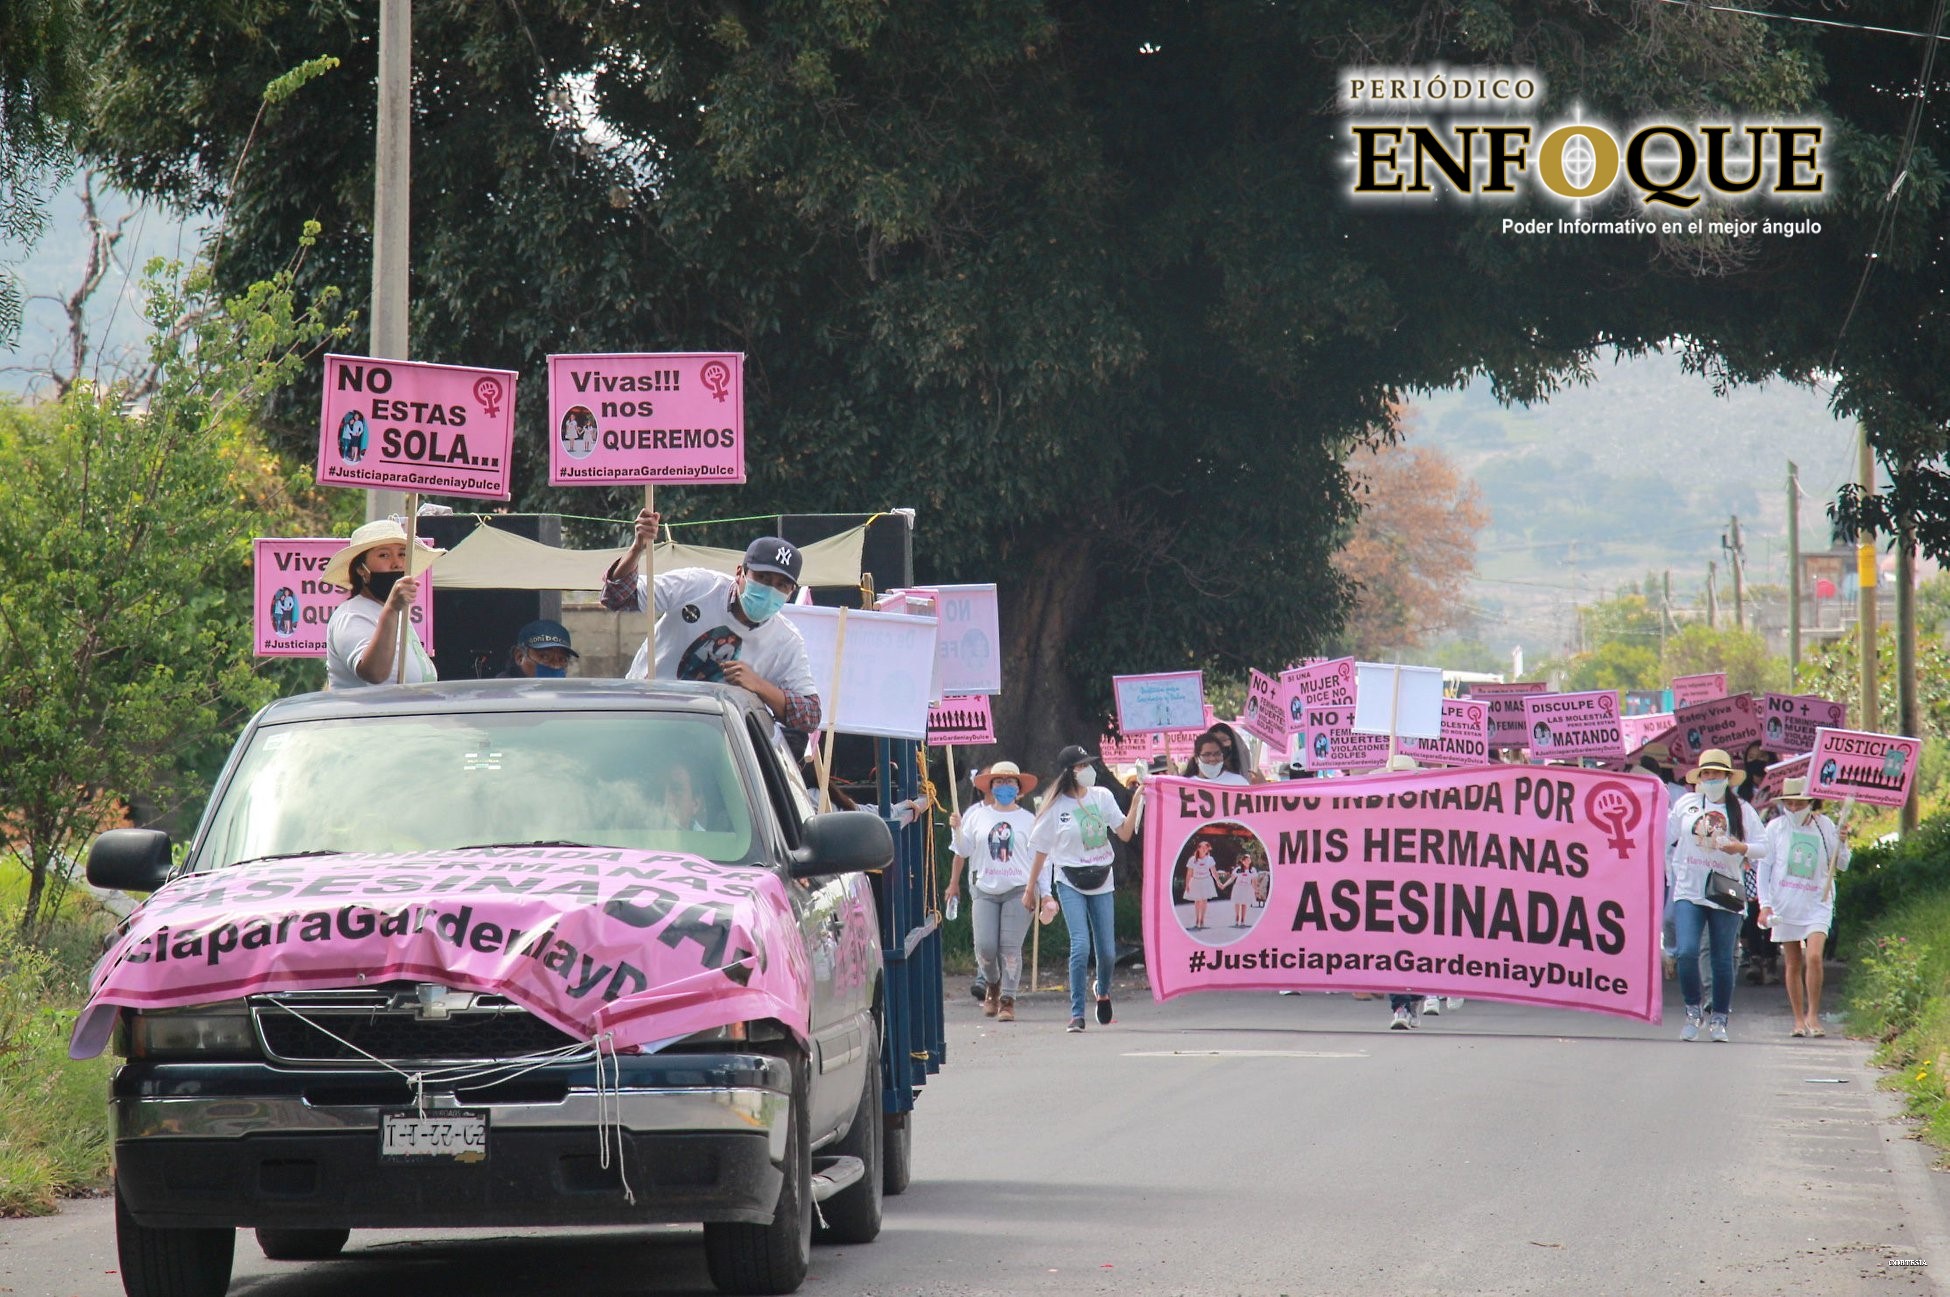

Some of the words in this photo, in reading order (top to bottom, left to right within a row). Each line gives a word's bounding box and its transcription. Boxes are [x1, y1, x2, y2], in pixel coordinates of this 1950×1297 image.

[338, 364, 392, 394] NO
[570, 370, 680, 392] Vivas!!!
[371, 399, 467, 427] ESTAS
[601, 401, 653, 417] nos
[381, 428, 499, 467] SOLA...
[603, 428, 735, 451] QUEREMOS
[329, 466, 500, 491] #JusticiaparaGardeniayDulce
[560, 465, 734, 478] #JusticiaparaGardeniayDulce
[274, 552, 330, 571] Viva
[1253, 676, 1268, 694] NO
[1300, 675, 1340, 694] MUJER
[1307, 691, 1329, 704] DICE
[1332, 687, 1347, 698] NO
[1532, 700, 1594, 713] DISCULPE
[1680, 710, 1706, 723] Estoy
[1708, 705, 1732, 717] Viva
[1769, 698, 1794, 713] NO
[1310, 712, 1338, 726] NO
[1547, 716, 1564, 724] LAS
[1566, 713, 1613, 722] MOLESTIAS
[1699, 719, 1736, 735] Puedo
[1330, 735, 1390, 744] MUERTES
[1553, 728, 1619, 747] MATANDO
[1711, 728, 1757, 745] Contarlo
[1419, 737, 1484, 756] MATANDO
[1515, 776, 1575, 824] POR
[1278, 828, 1348, 867] MIS
[1364, 828, 1589, 878] HERMANAS
[640, 855, 763, 881] POR
[1291, 879, 1626, 955] ASESINADAS
[1189, 948, 1629, 996] #JusticiaparaGardeniayDulce
